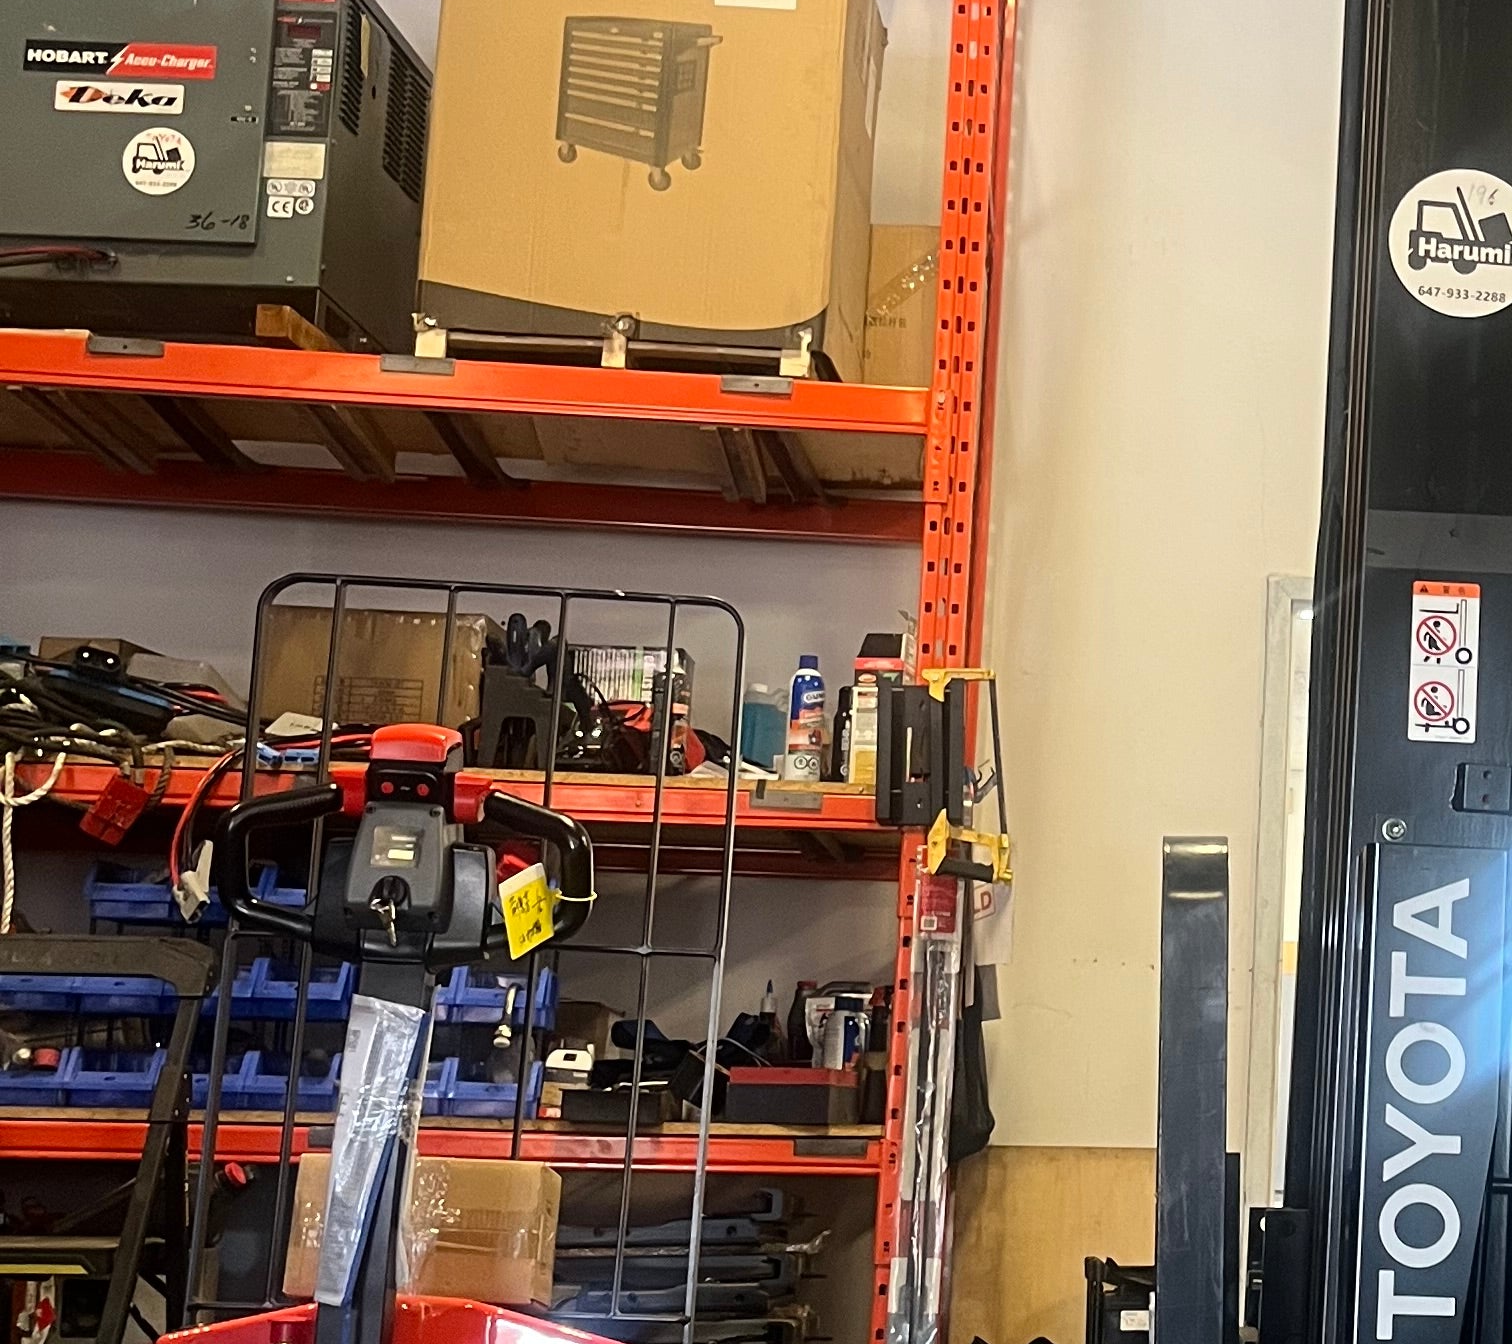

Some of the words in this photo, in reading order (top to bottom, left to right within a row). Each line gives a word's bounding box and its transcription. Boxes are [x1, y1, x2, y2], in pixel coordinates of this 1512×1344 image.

[27, 49, 109, 64] HOBART
[124, 53, 212, 71] Accu-Charger
[60, 86, 178, 107] Deka
[185, 211, 250, 231] 36-18
[1418, 236, 1512, 265] Harumi
[1417, 285, 1507, 304] 647-933-2288
[1376, 878, 1471, 1342] TOYOTA
